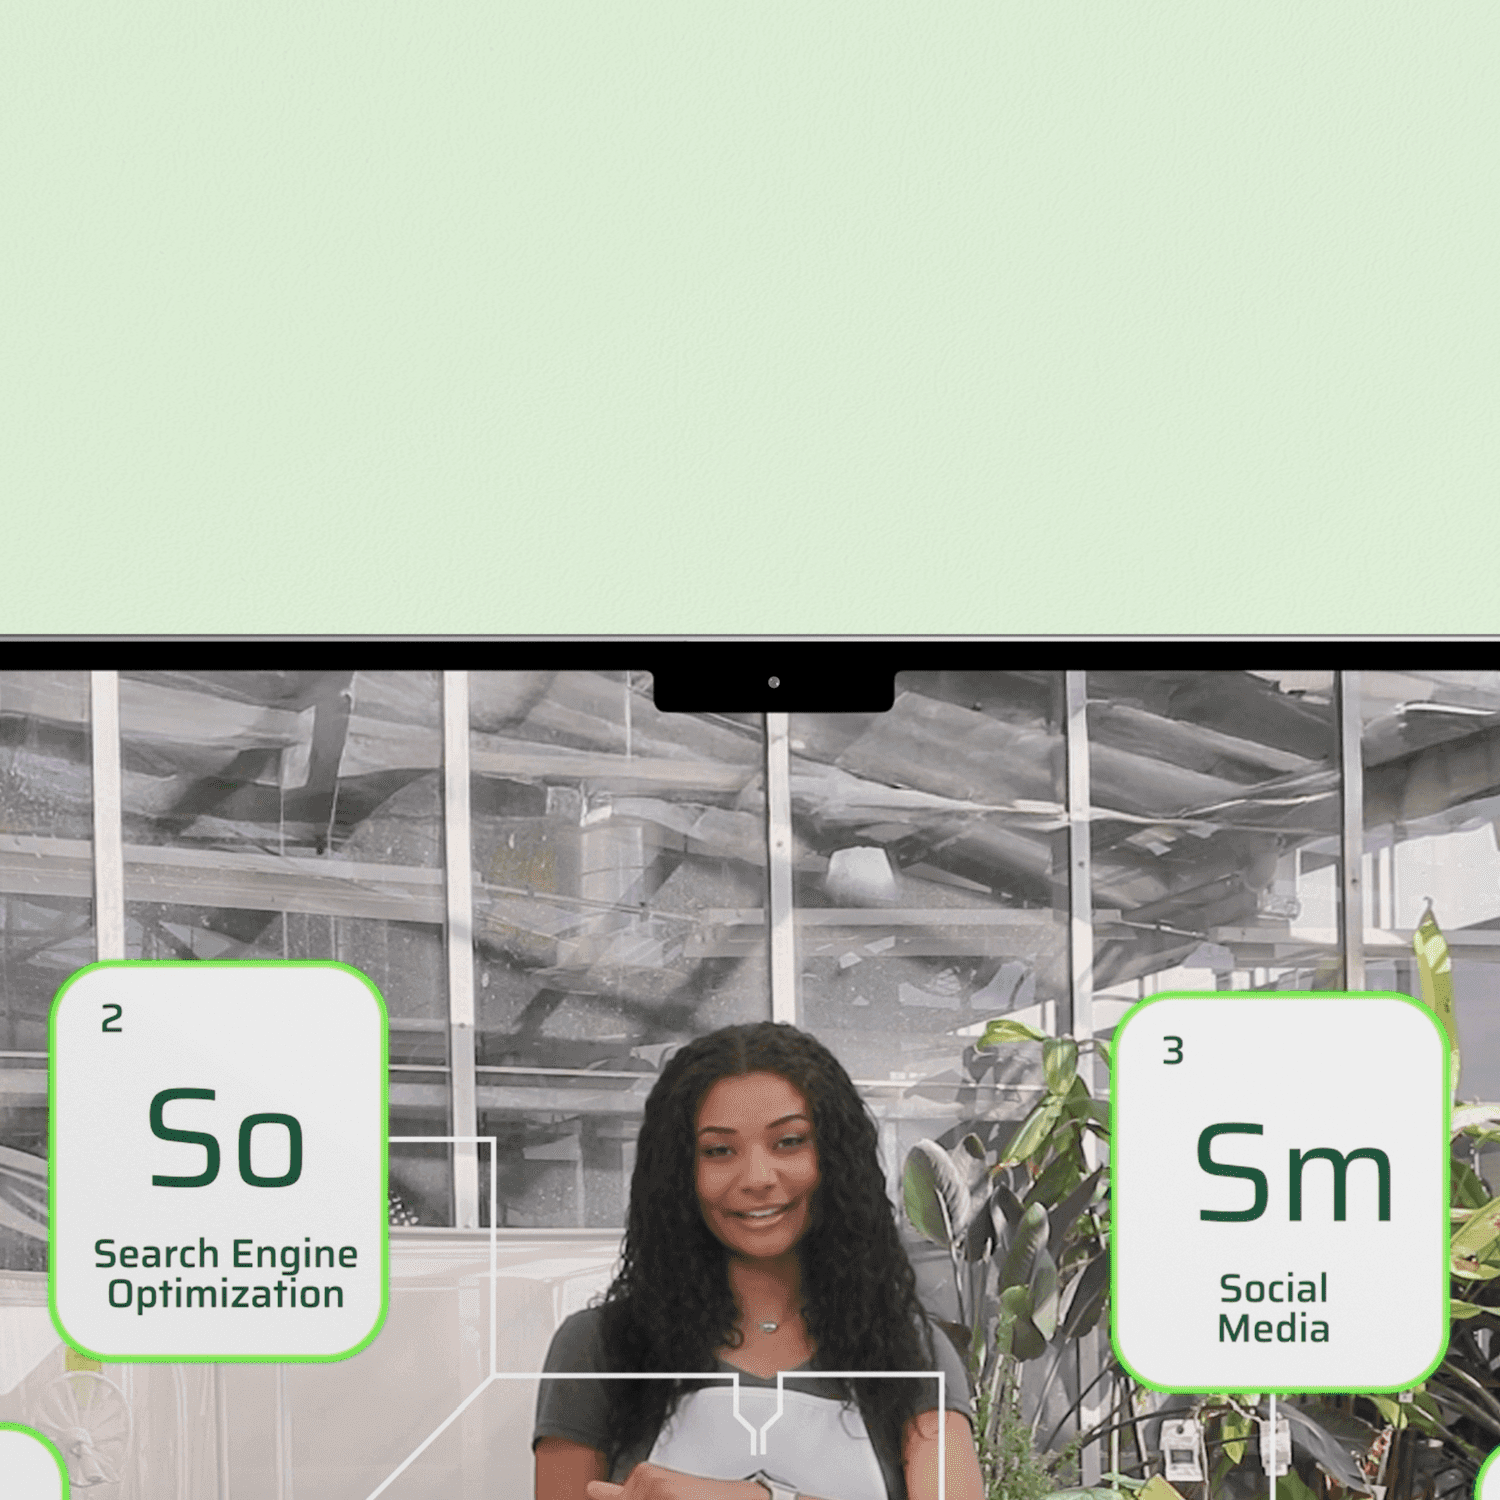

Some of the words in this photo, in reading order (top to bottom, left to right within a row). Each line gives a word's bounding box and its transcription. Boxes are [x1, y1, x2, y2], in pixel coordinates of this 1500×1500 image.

[101, 1003, 123, 1033] 2
[1163, 1035, 1184, 1065] 3
[149, 1087, 303, 1188] So
[1197, 1122, 1391, 1223] Sm
[94, 1236, 219, 1269] Search
[233, 1237, 358, 1277] Engine
[108, 1276, 344, 1316] Optimization
[1220, 1271, 1328, 1303] Social
[1219, 1311, 1329, 1343] Media
